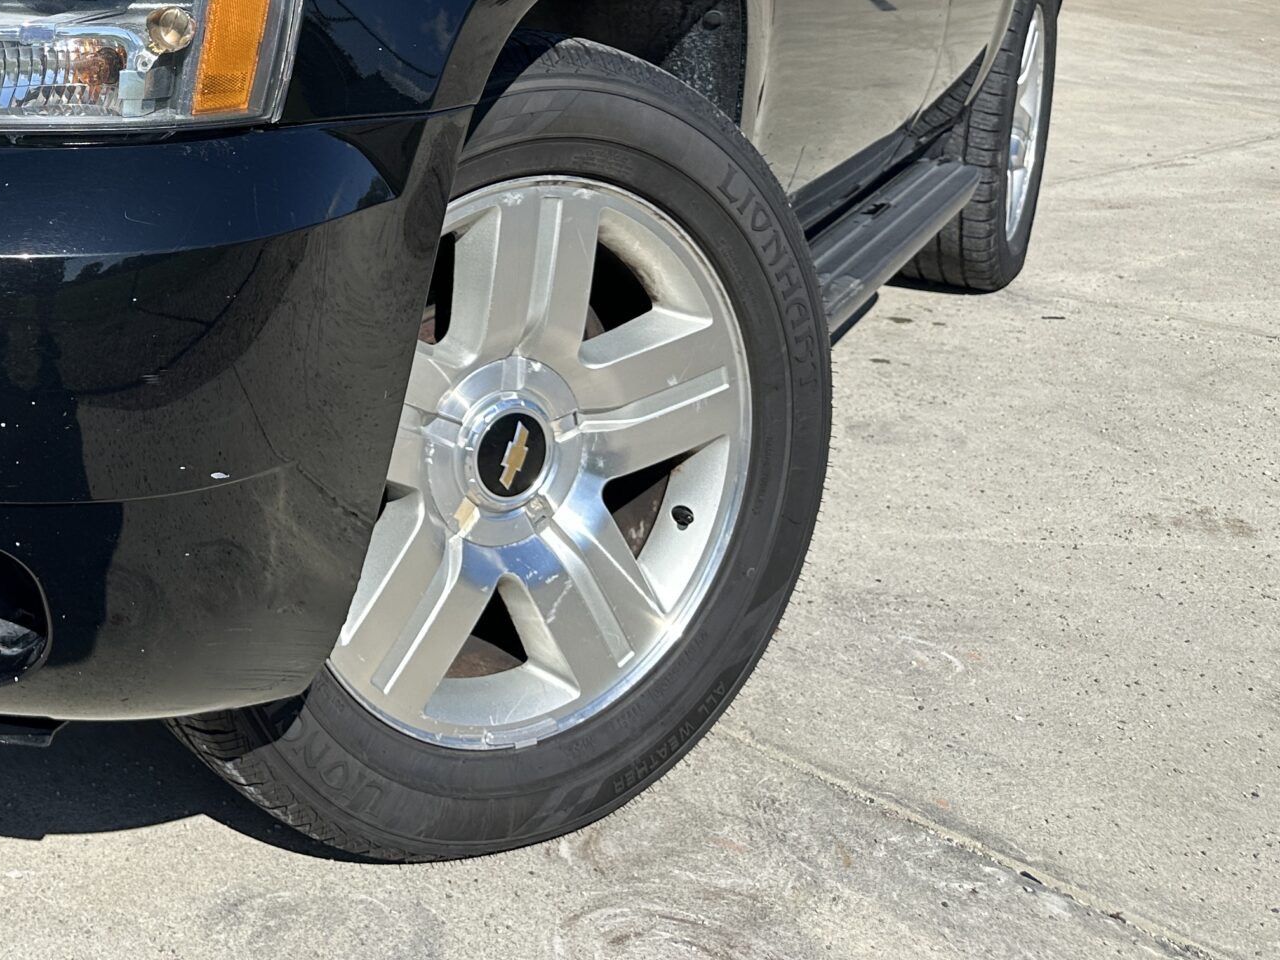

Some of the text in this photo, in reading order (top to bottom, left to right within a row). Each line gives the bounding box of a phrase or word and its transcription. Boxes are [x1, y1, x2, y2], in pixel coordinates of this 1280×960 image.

[717, 163, 817, 387] LIONHART
[697, 680, 726, 716] ALL
[612, 720, 696, 794] WEATHER
